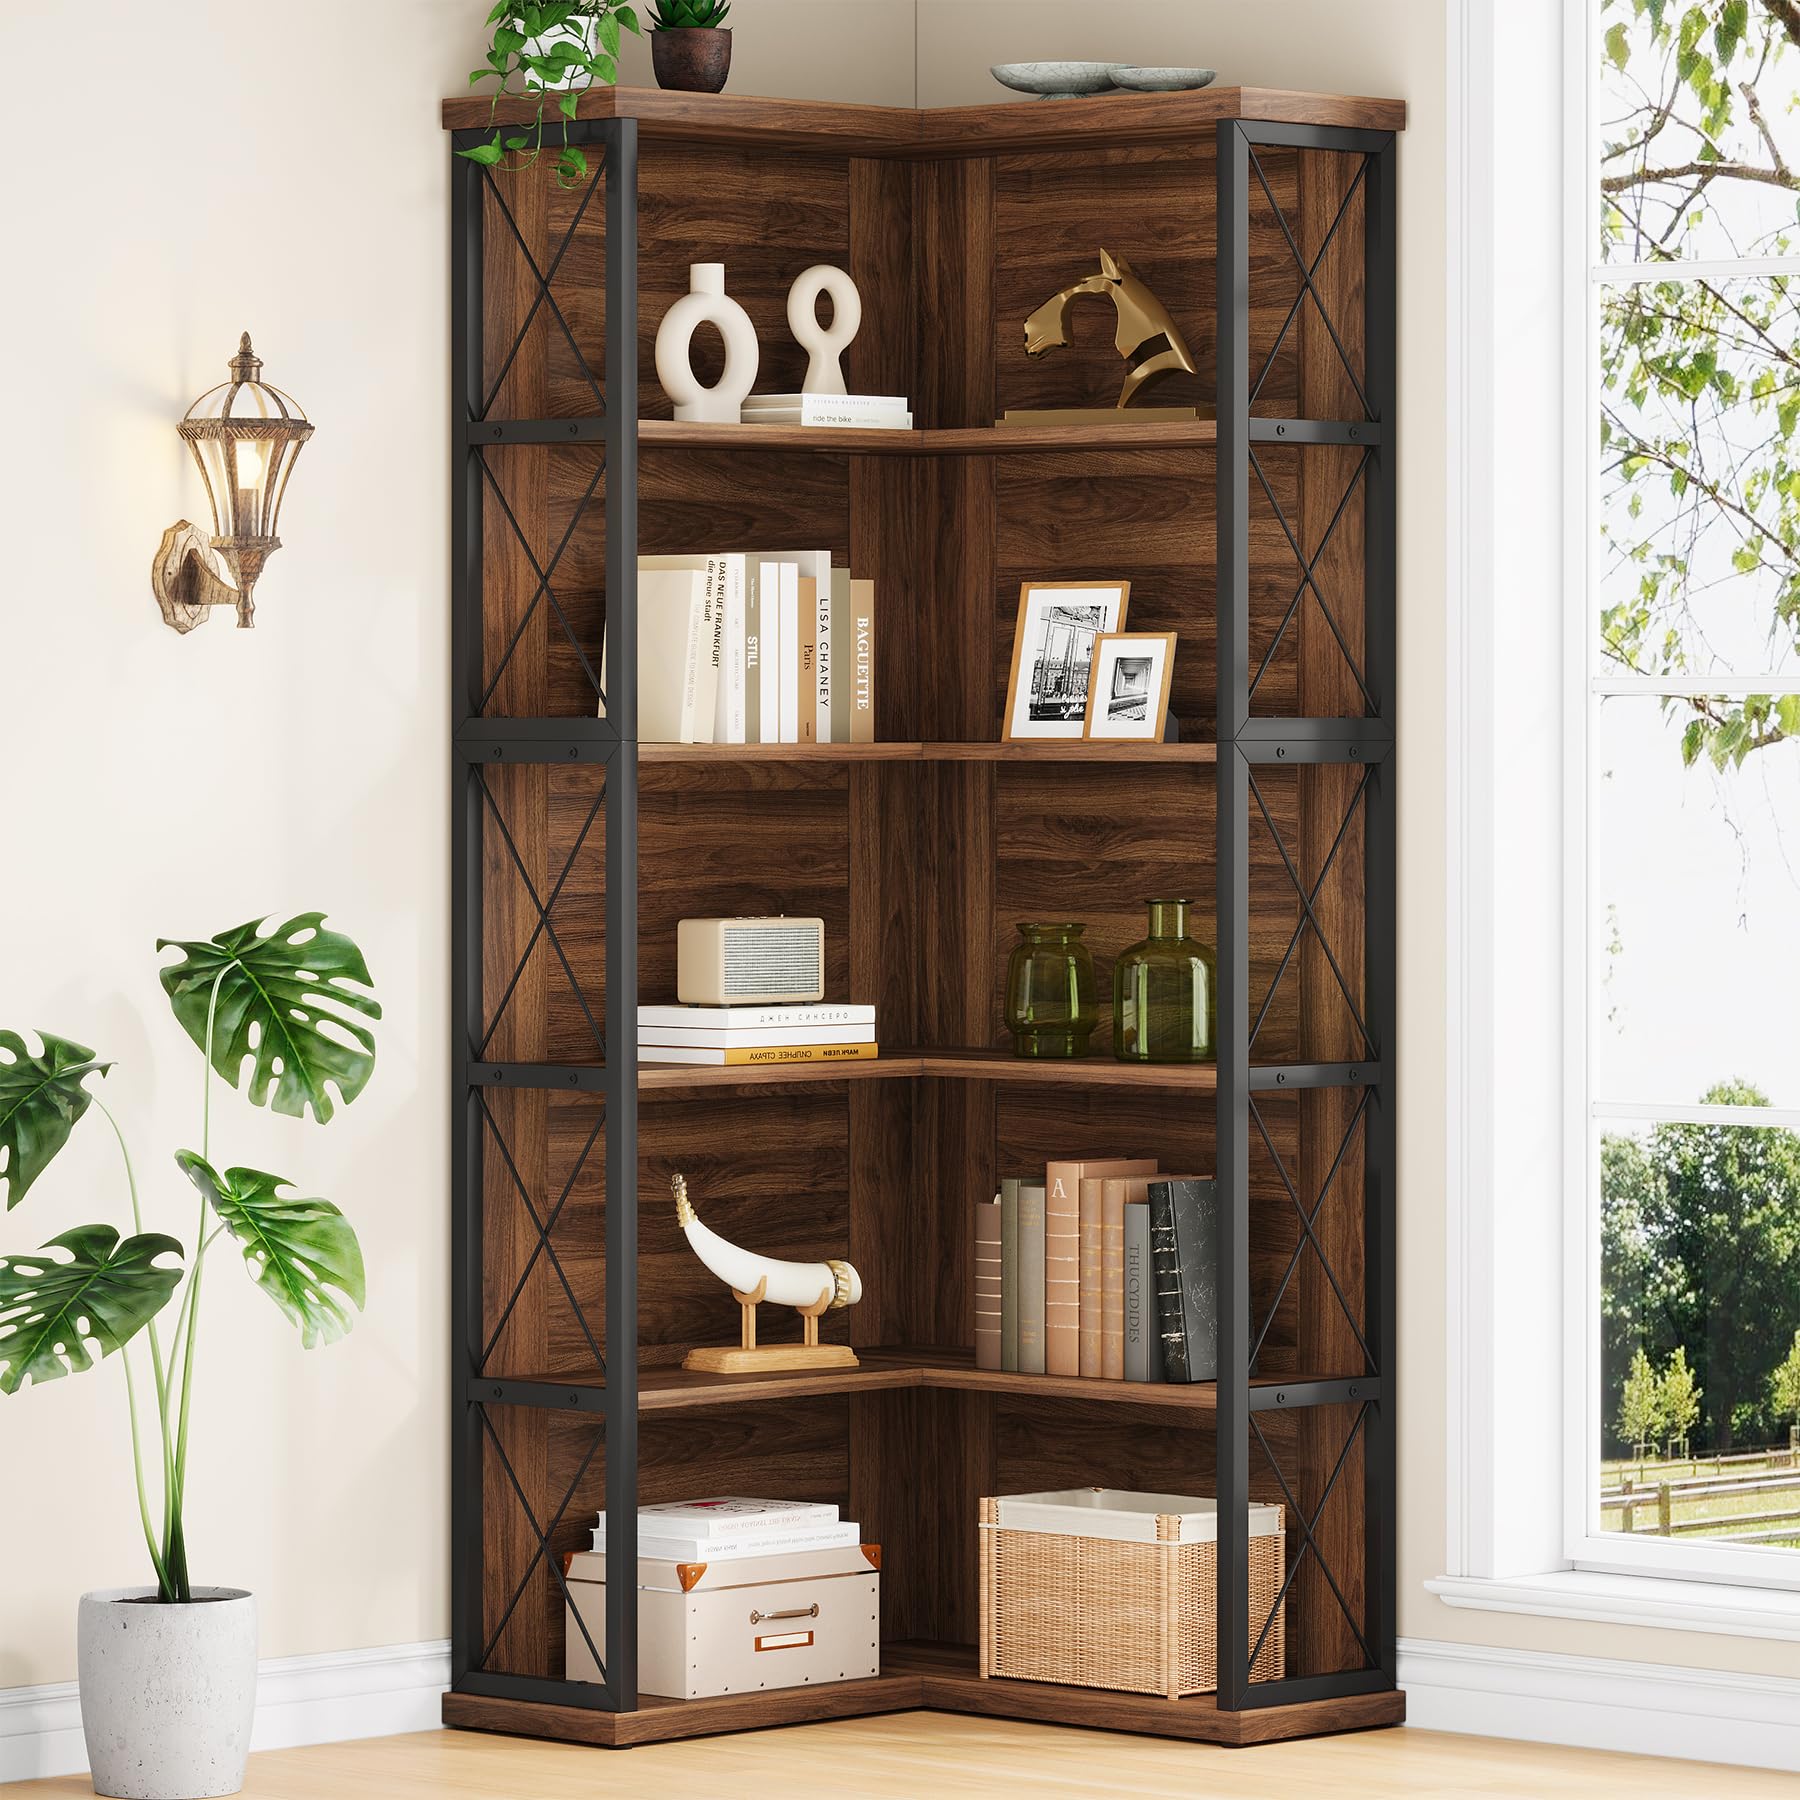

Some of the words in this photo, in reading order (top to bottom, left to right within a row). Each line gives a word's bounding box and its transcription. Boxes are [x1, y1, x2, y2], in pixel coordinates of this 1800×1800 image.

[827, 415, 837, 423] the
[838, 415, 852, 423] bike
[707, 560, 715, 574] die
[717, 561, 726, 582] DAS
[705, 575, 713, 597] neue
[716, 584, 725, 610] NEUE
[704, 599, 712, 622] stadt
[819, 598, 829, 633] LISA
[712, 612, 722, 669] FRANKFURT
[747, 636, 758, 669] STILL
[804, 644, 814, 671] Paris
[856, 617, 869, 710] BAGUETTE
[819, 642, 829, 707] CHANEY
[798, 1012, 849, 1021] СИНСЕРО
[1051, 1178, 1067, 1199] A
[1129, 1244, 1140, 1343] THUCYDIDES
